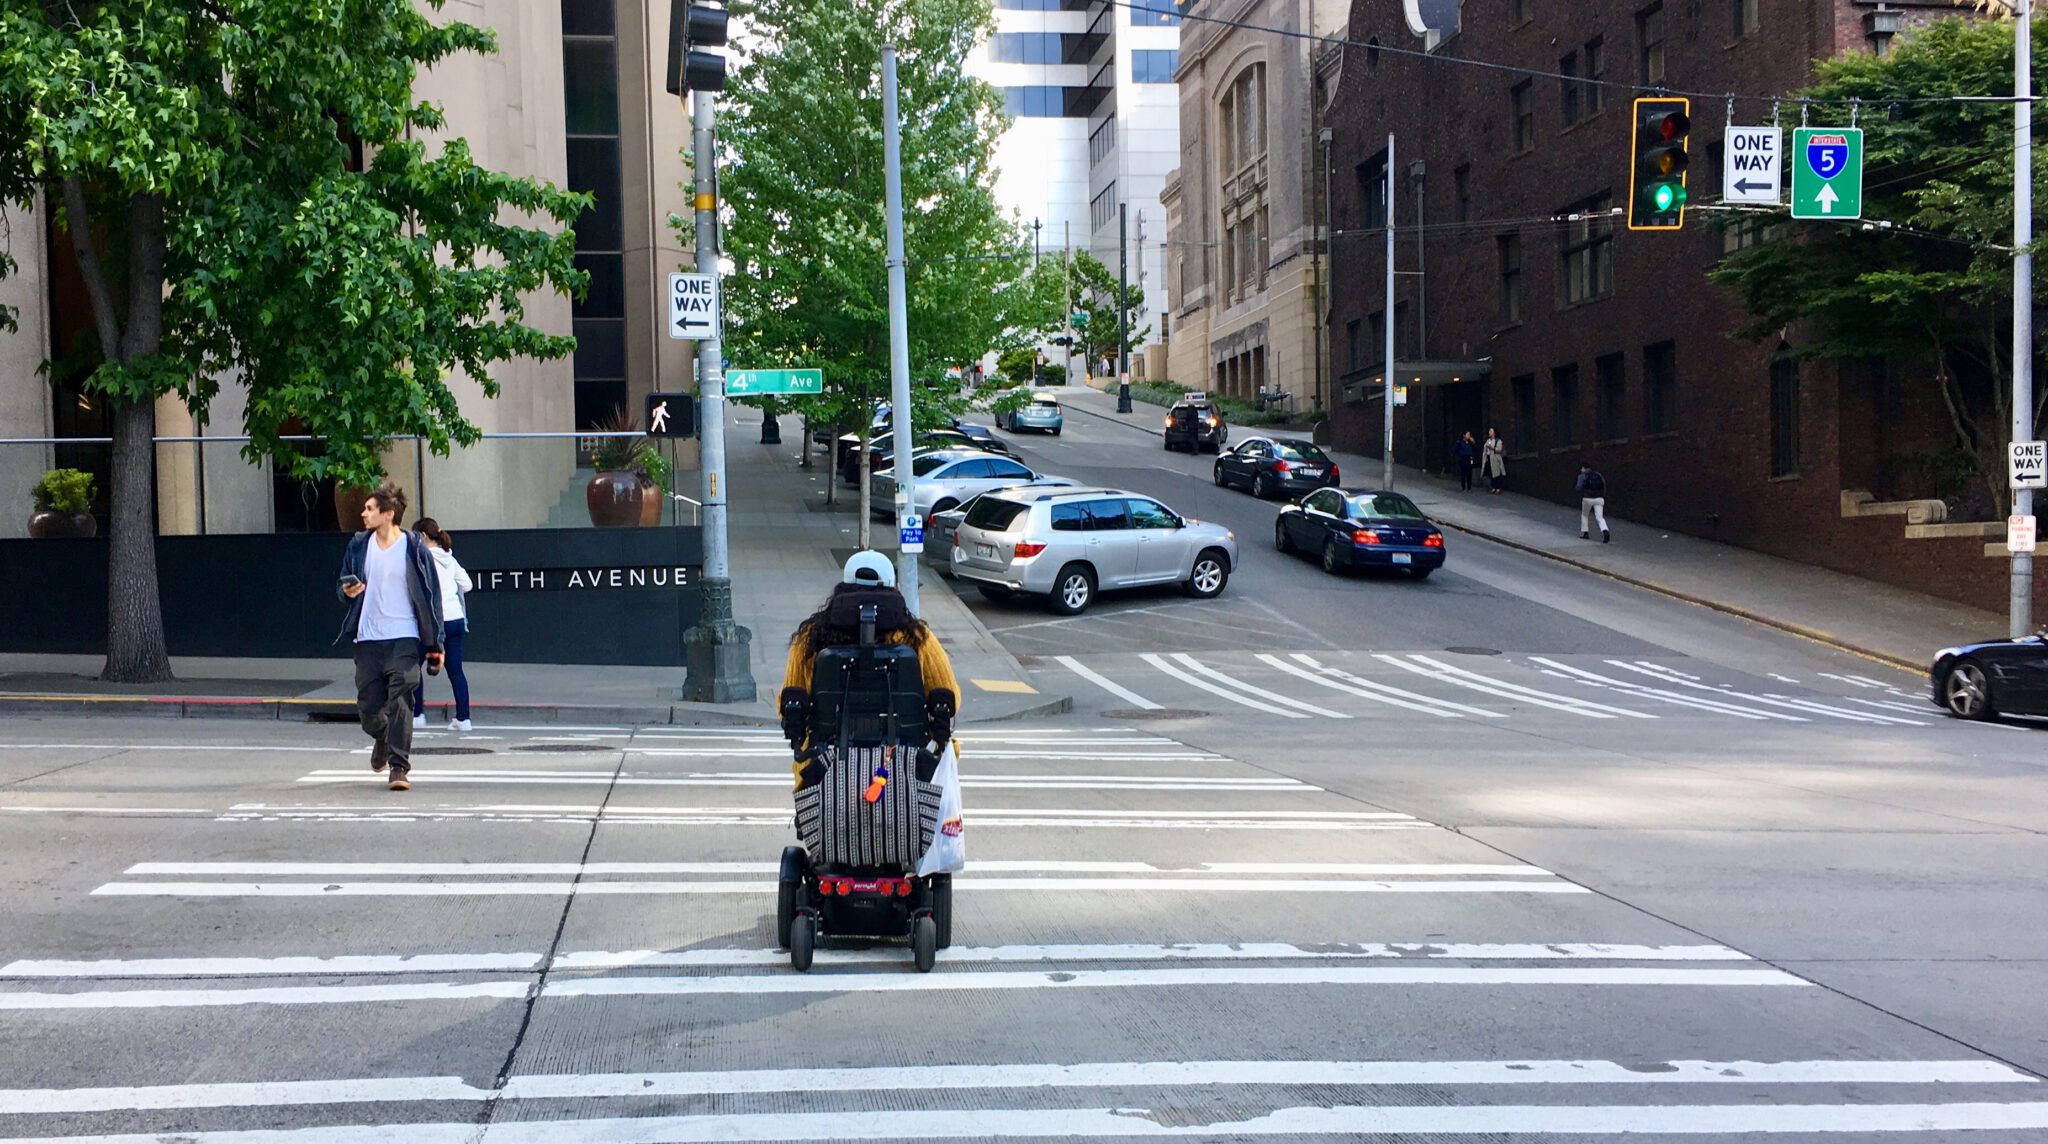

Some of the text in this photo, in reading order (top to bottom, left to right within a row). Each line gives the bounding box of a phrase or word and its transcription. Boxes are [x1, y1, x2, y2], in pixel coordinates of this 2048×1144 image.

[1734, 135, 1773, 150] ONE
[1734, 155, 1773, 170] WAY
[1821, 149, 1835, 172] 5
[675, 279, 712, 294] ONE
[675, 297, 712, 312] WAY
[732, 373, 813, 391] 4th Ave
[2014, 445, 2042, 456] ONE
[2014, 458, 2043, 470] WAY
[902, 529, 913, 537] Pay
[477, 571, 545, 589] IFTH
[568, 568, 687, 588] AVENUE
